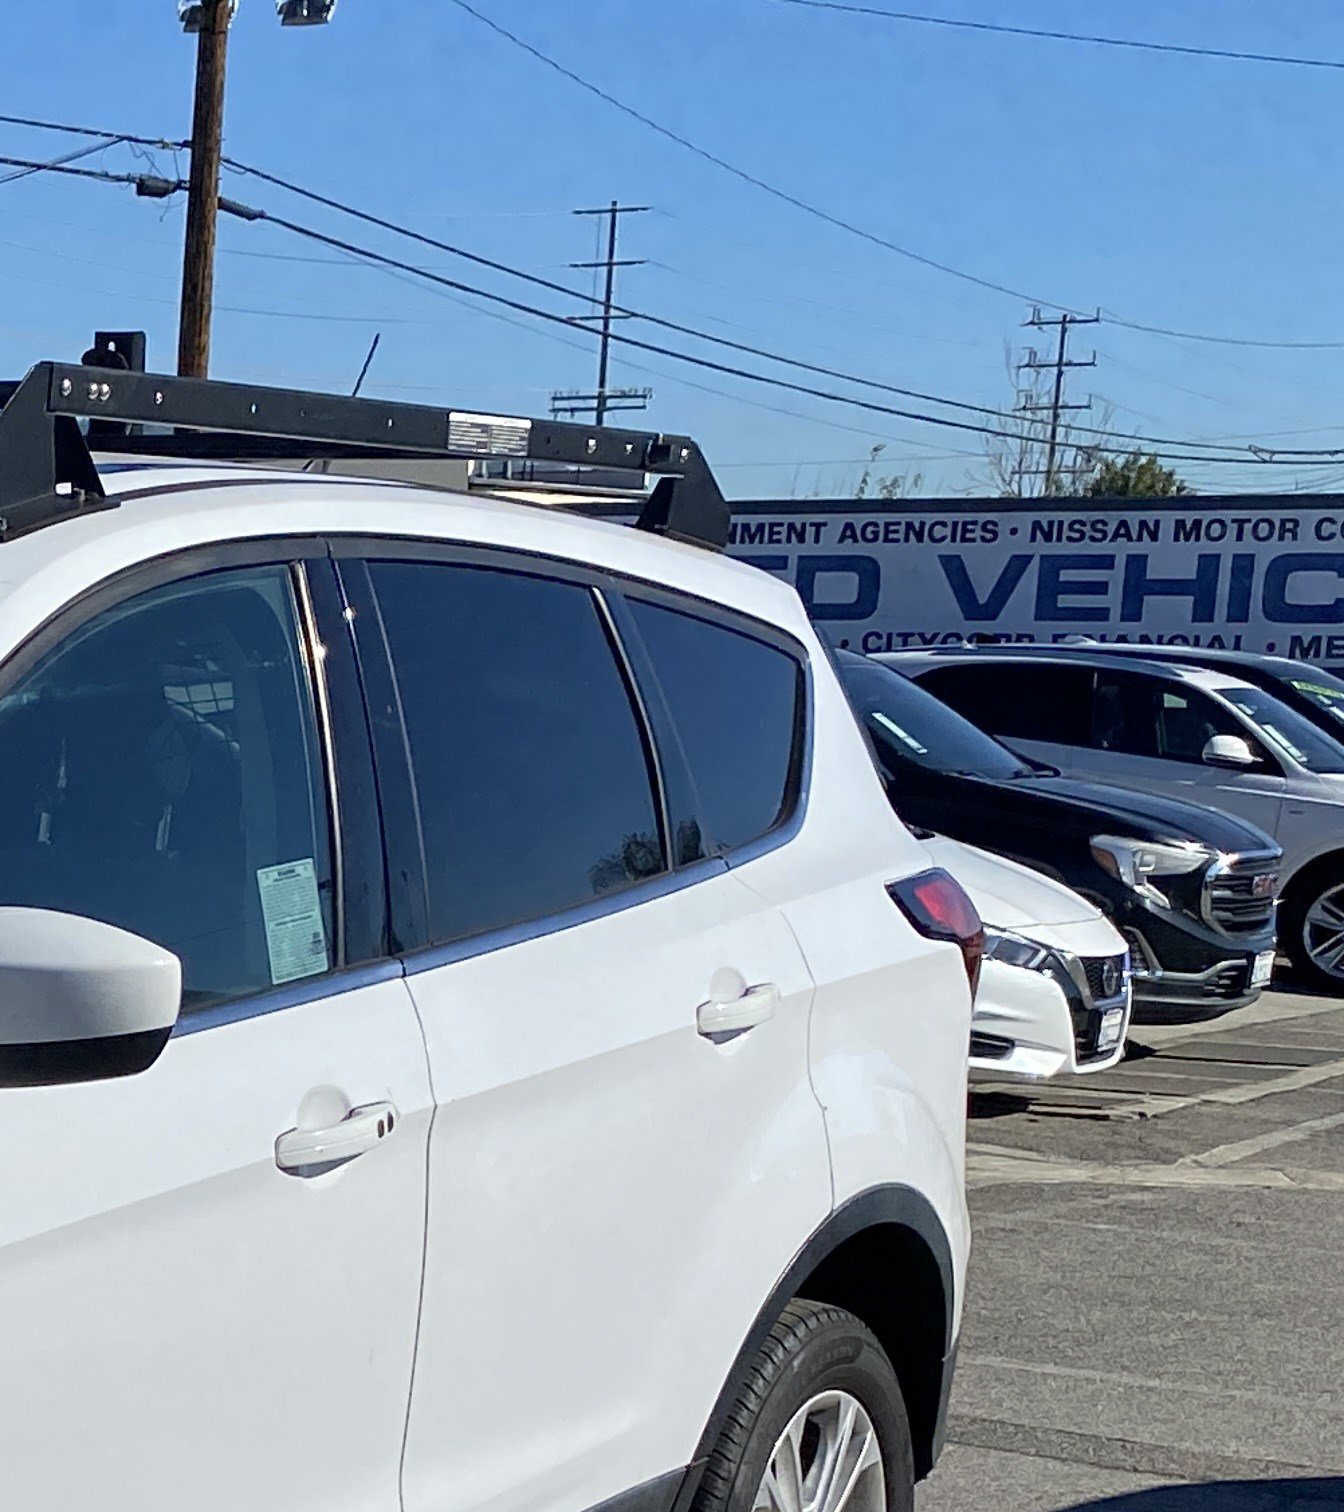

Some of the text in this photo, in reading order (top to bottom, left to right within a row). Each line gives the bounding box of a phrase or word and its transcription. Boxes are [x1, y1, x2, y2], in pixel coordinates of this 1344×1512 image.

[838, 519, 1000, 545] AGENCIES
[1030, 518, 1161, 544] NISSAN
[1172, 517, 1301, 543] MOTOR
[1315, 517, 1344, 542] C
[726, 553, 1344, 624] D VEHIC
